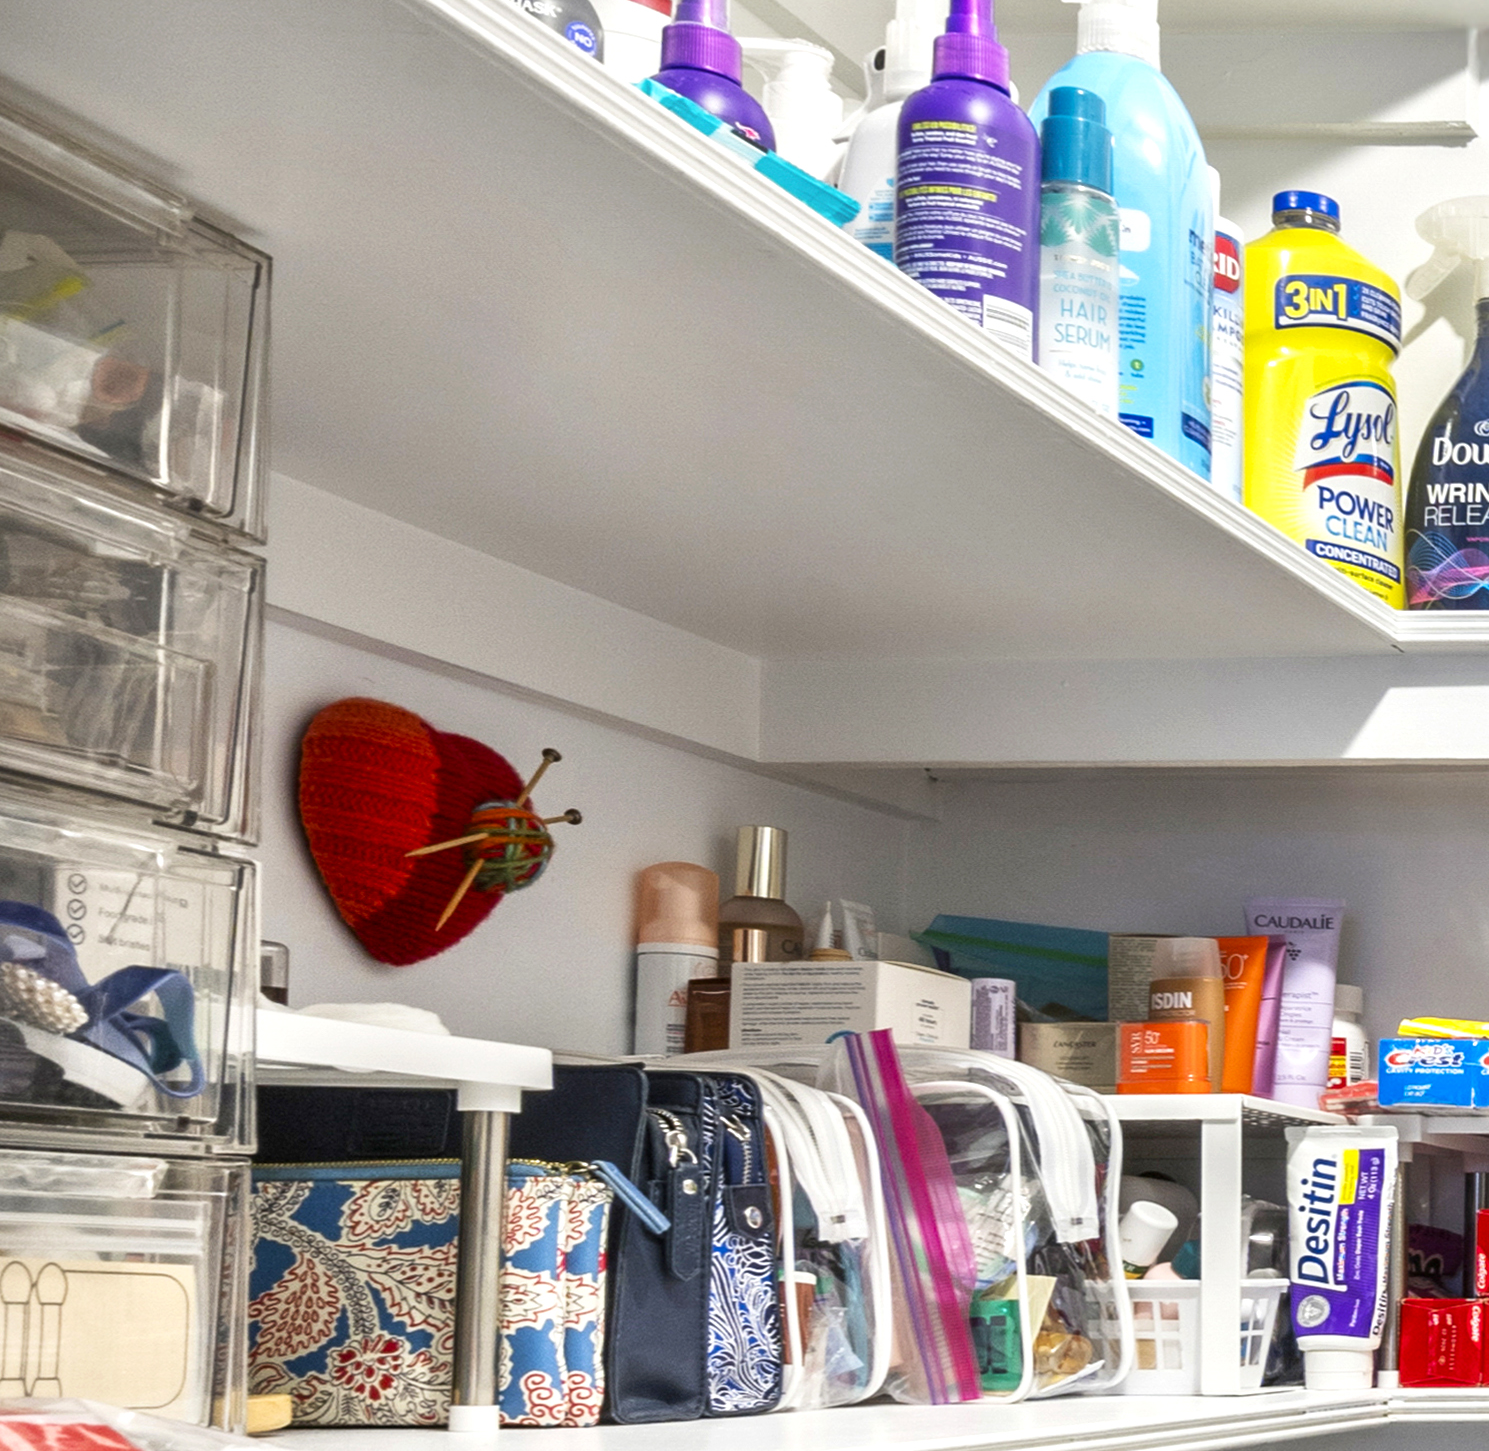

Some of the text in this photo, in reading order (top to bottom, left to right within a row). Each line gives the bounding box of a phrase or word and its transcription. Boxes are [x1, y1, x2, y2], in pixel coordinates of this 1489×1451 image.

[1060, 298, 1108, 327] HAIR
[1054, 323, 1111, 352] SERUM
[1309, 391, 1394, 459] Lysol
[1317, 485, 1394, 533] POWER
[1325, 515, 1388, 552] CLEAN
[1315, 543, 1398, 579] CONCENTRATED
[1152, 992, 1193, 1009] ISDIN
[1131, 1032, 1142, 1054] SVR
[1386, 1051, 1465, 1067] Crest
[1413, 1044, 1455, 1055] KID'S
[1386, 1067, 1465, 1075] CAVITY PROTECTION
[1358, 1171, 1370, 1200] NET WT
[1297, 1157, 1337, 1285] Desitin
[1336, 1208, 1351, 1281] Maximum Strength
[1477, 1252, 1486, 1289] Colgate
[1372, 1289, 1388, 1335] Desitin
[1470, 1305, 1482, 1342] Colgate
